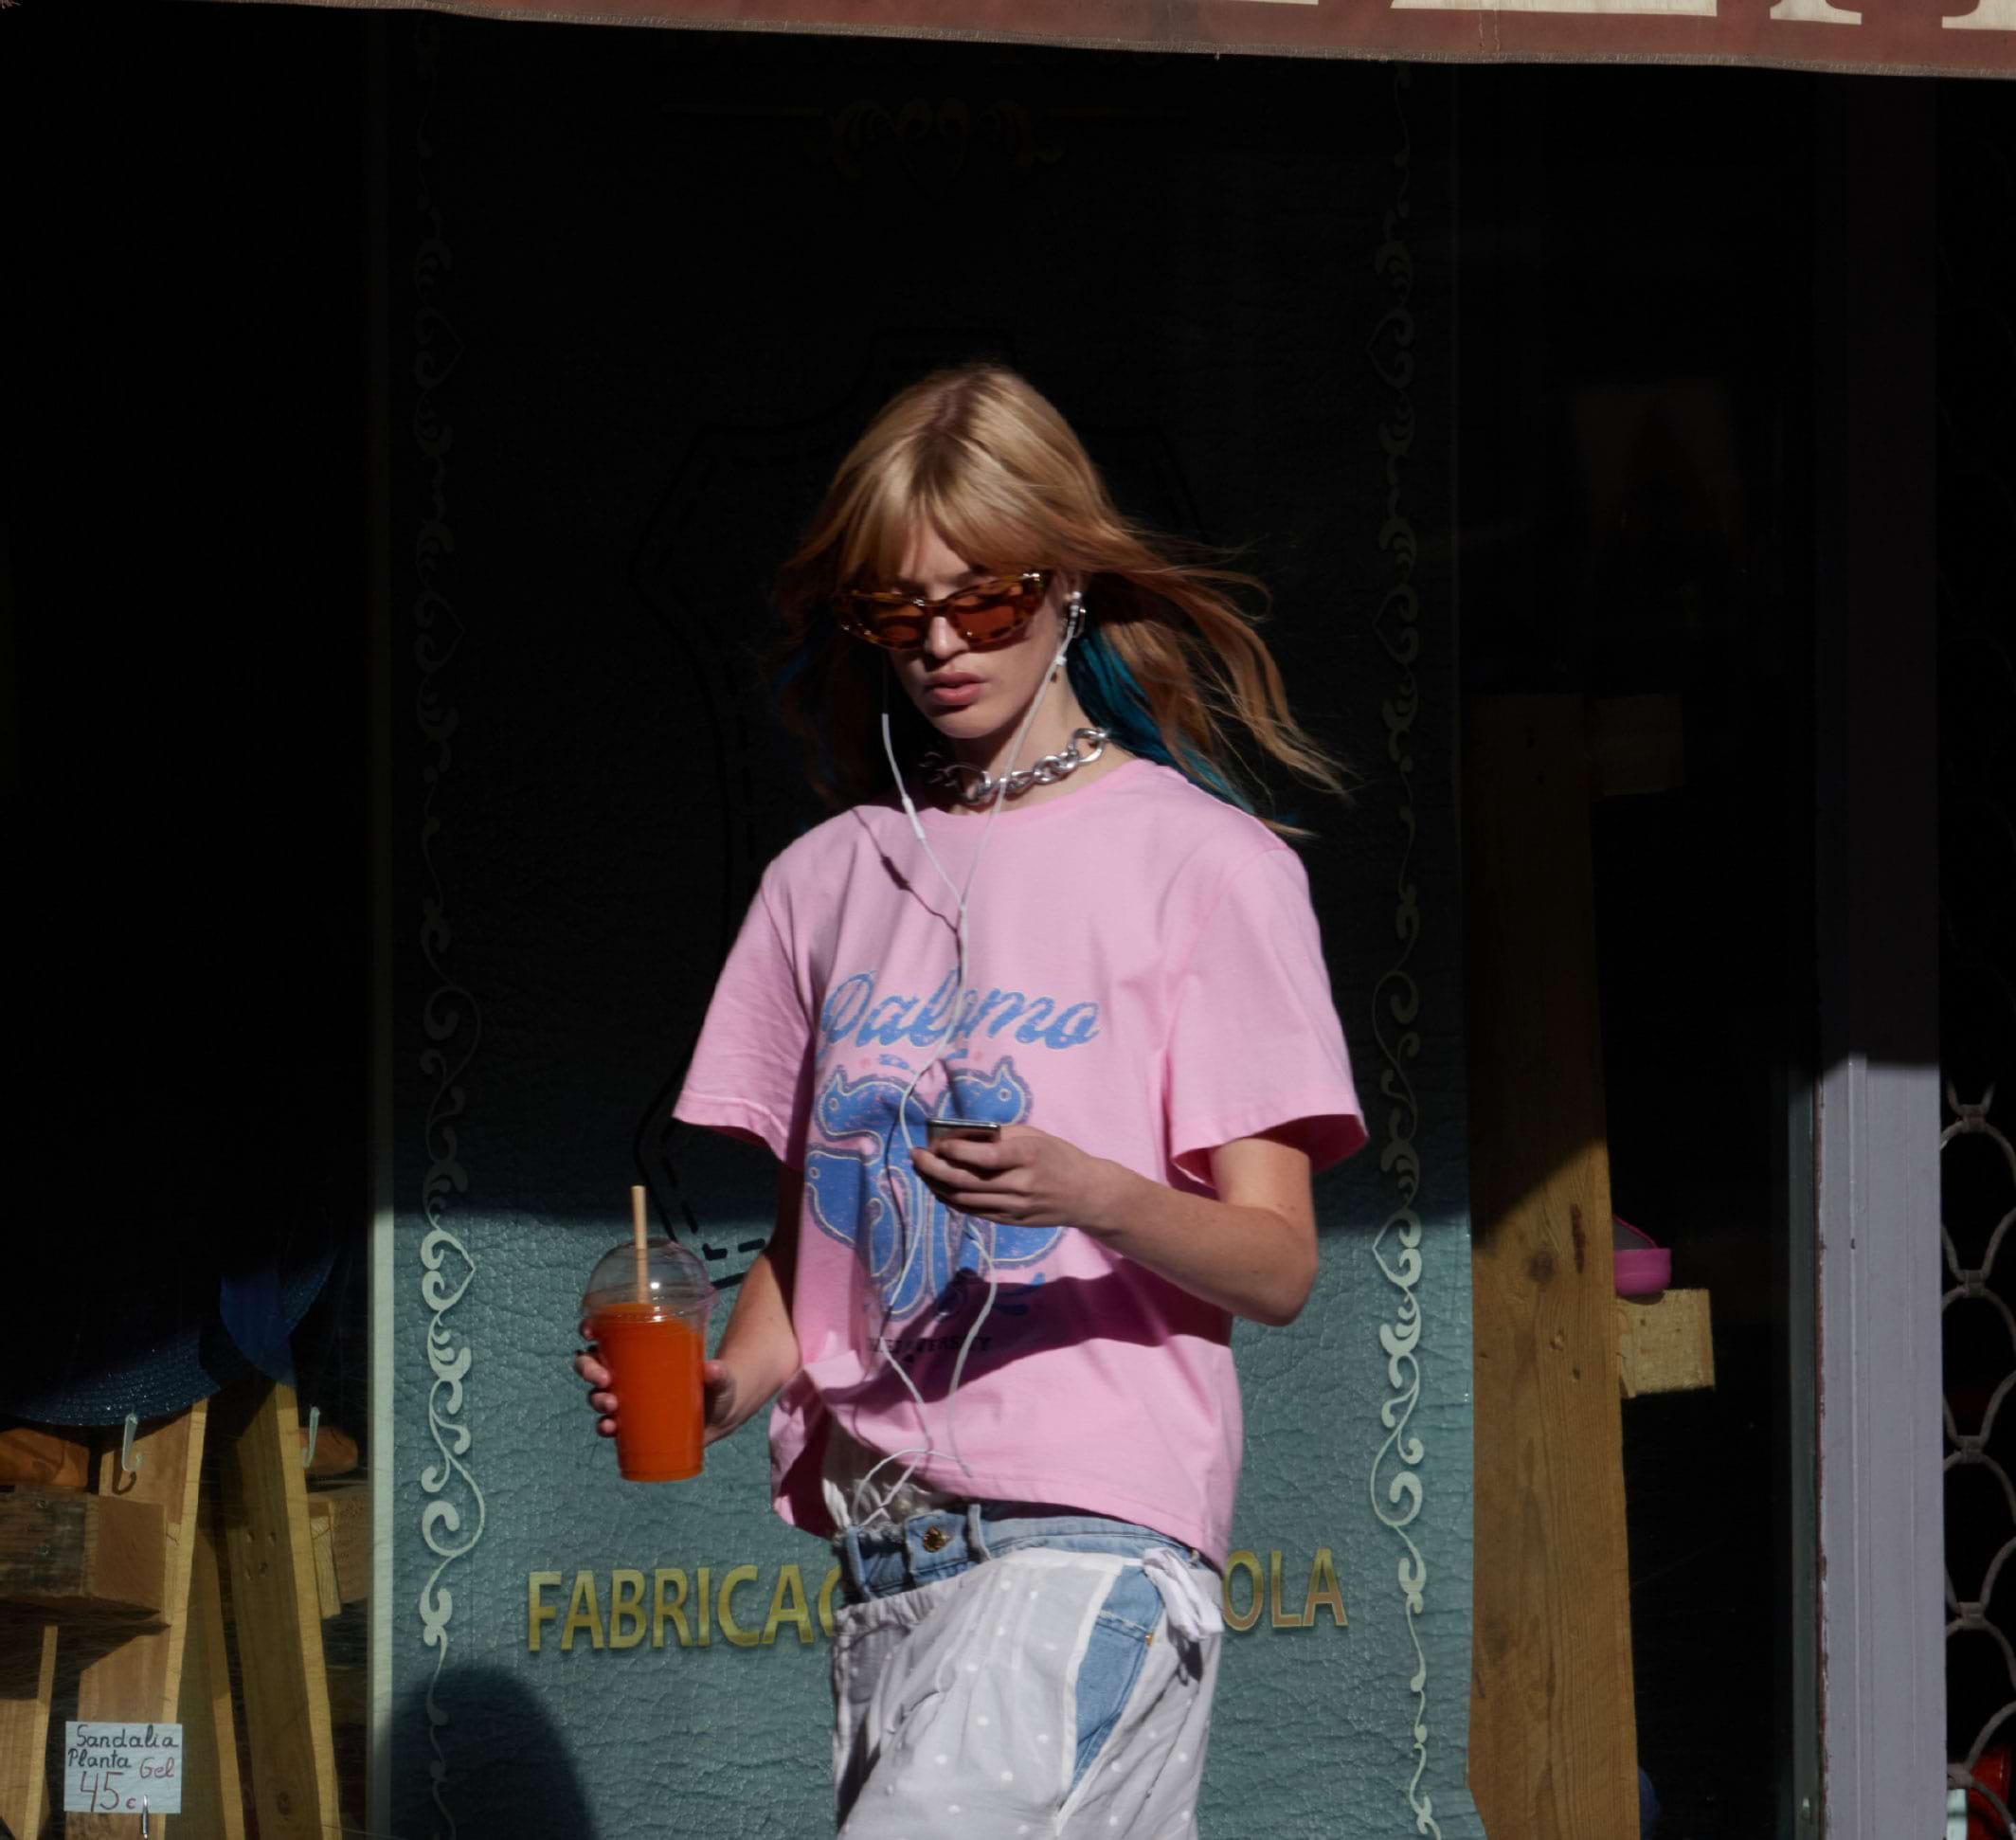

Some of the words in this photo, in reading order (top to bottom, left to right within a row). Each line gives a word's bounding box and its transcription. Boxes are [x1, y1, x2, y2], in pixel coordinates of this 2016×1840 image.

[76, 1723, 179, 1748] Sandalia
[67, 1747, 132, 1769] Planta
[139, 1756, 175, 1779] Gel
[80, 1771, 124, 1813] 45
